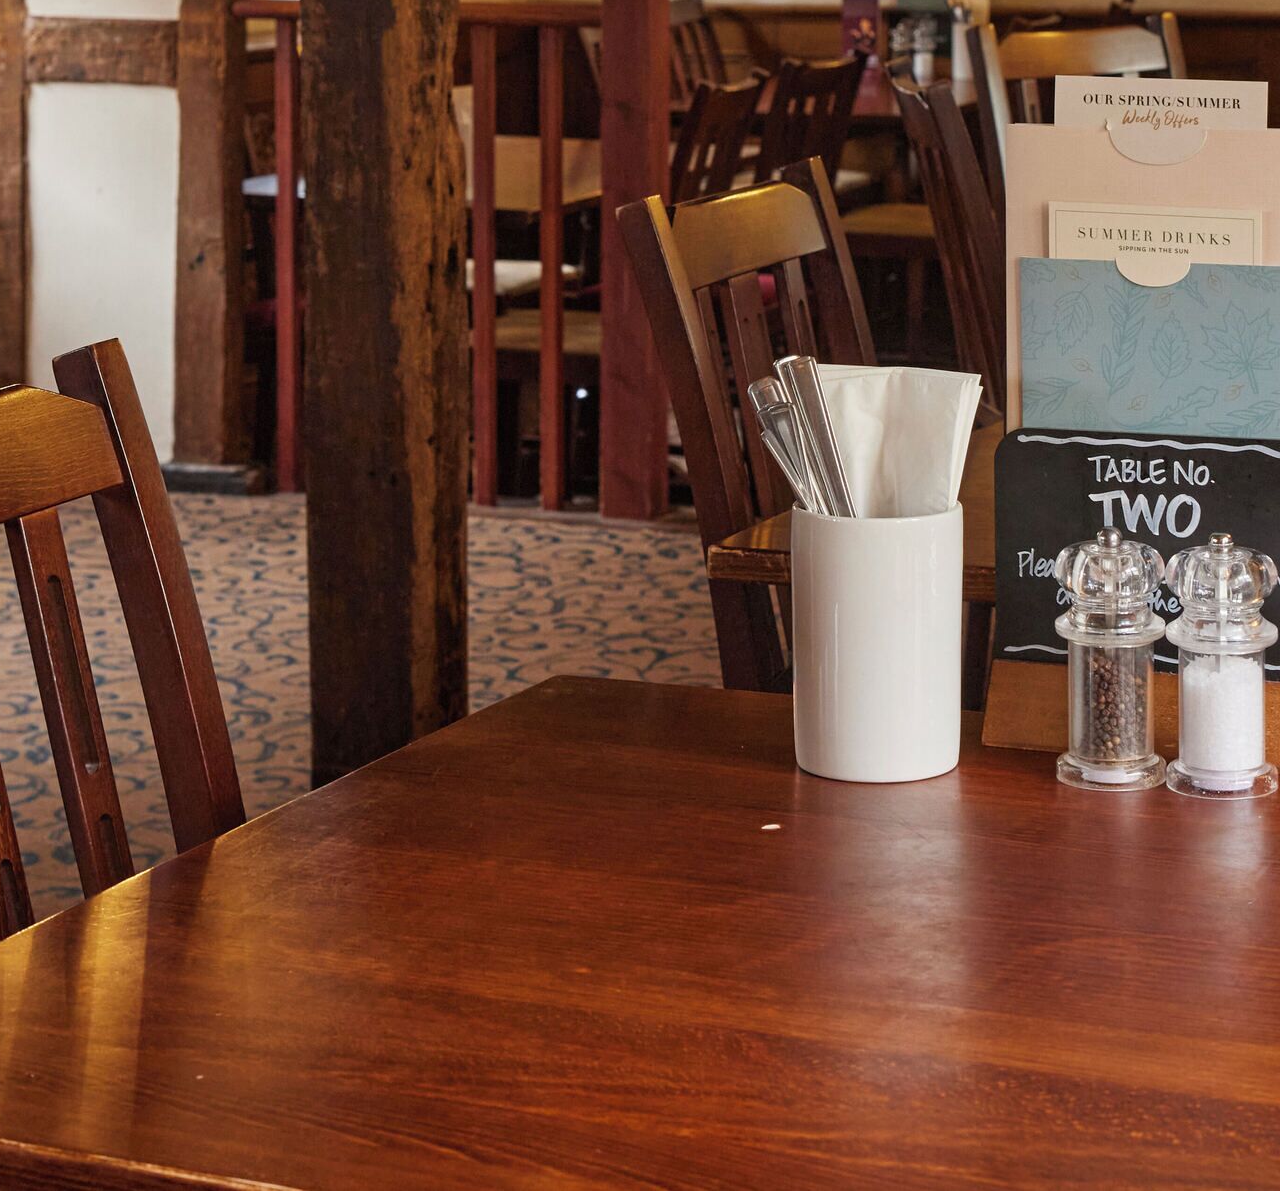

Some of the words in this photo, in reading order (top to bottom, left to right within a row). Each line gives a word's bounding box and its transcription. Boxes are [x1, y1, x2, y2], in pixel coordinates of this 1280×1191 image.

[1083, 93, 1114, 105] OUR
[1118, 95, 1241, 109] SPRING/SUMMER
[1122, 109, 1161, 130] Weekly
[1164, 110, 1199, 128] Offers
[1077, 226, 1153, 242] SUMMER
[1162, 230, 1232, 246] DRINKS
[1118, 245, 1147, 253] SIPPING
[1087, 455, 1167, 485] TABLE
[1088, 490, 1202, 538] TWO
[1017, 548, 1057, 579] Plea
